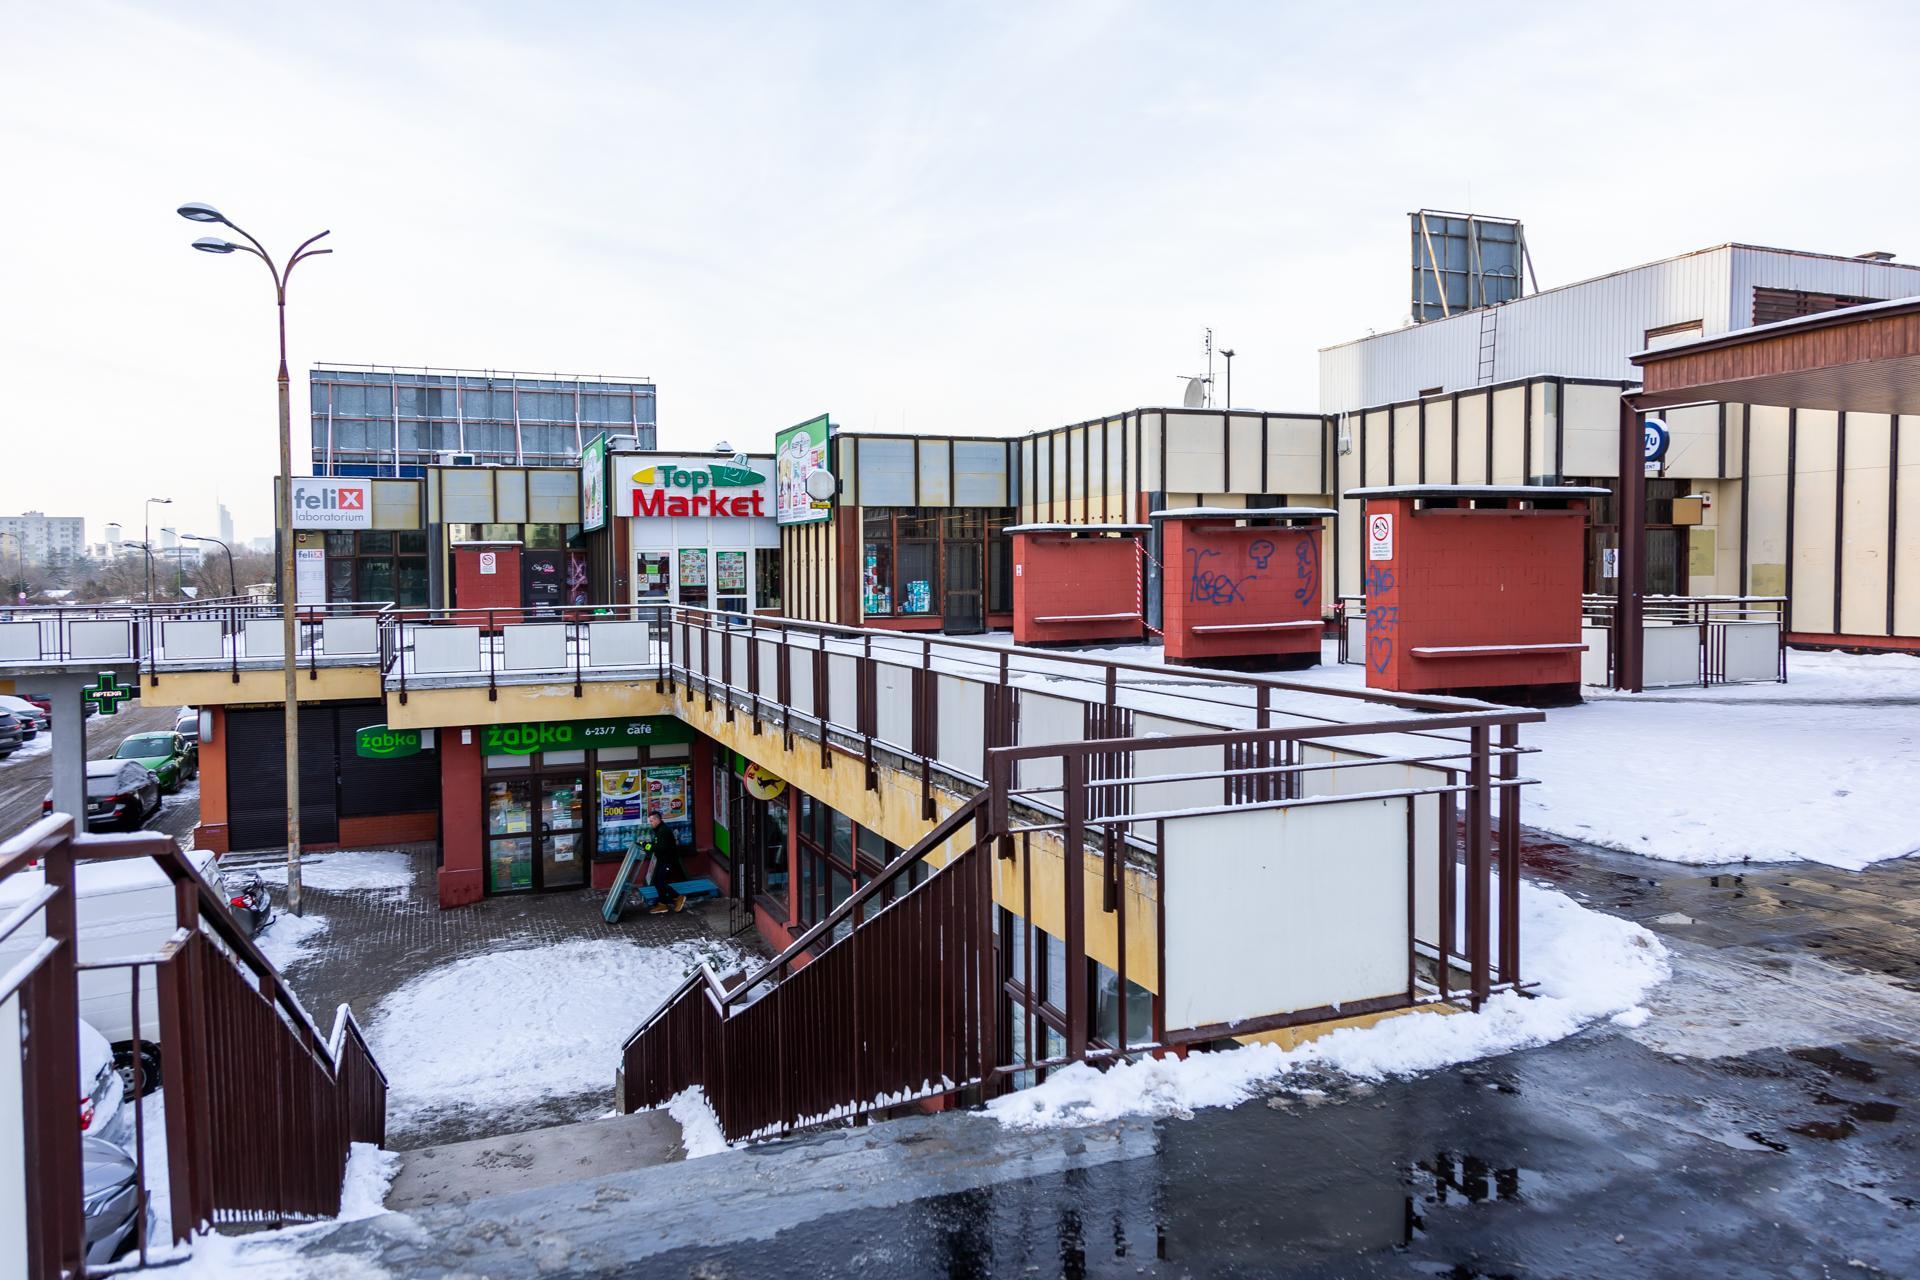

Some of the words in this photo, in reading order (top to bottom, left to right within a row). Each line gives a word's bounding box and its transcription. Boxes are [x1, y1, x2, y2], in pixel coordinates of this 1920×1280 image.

[657, 465, 709, 494] Top
[632, 489, 764, 516] Market
[296, 511, 363, 521] laboratorium
[361, 733, 417, 748] żabka
[488, 722, 573, 746] żabka
[585, 726, 616, 736] 6-23/7
[604, 806, 624, 816] 5000
